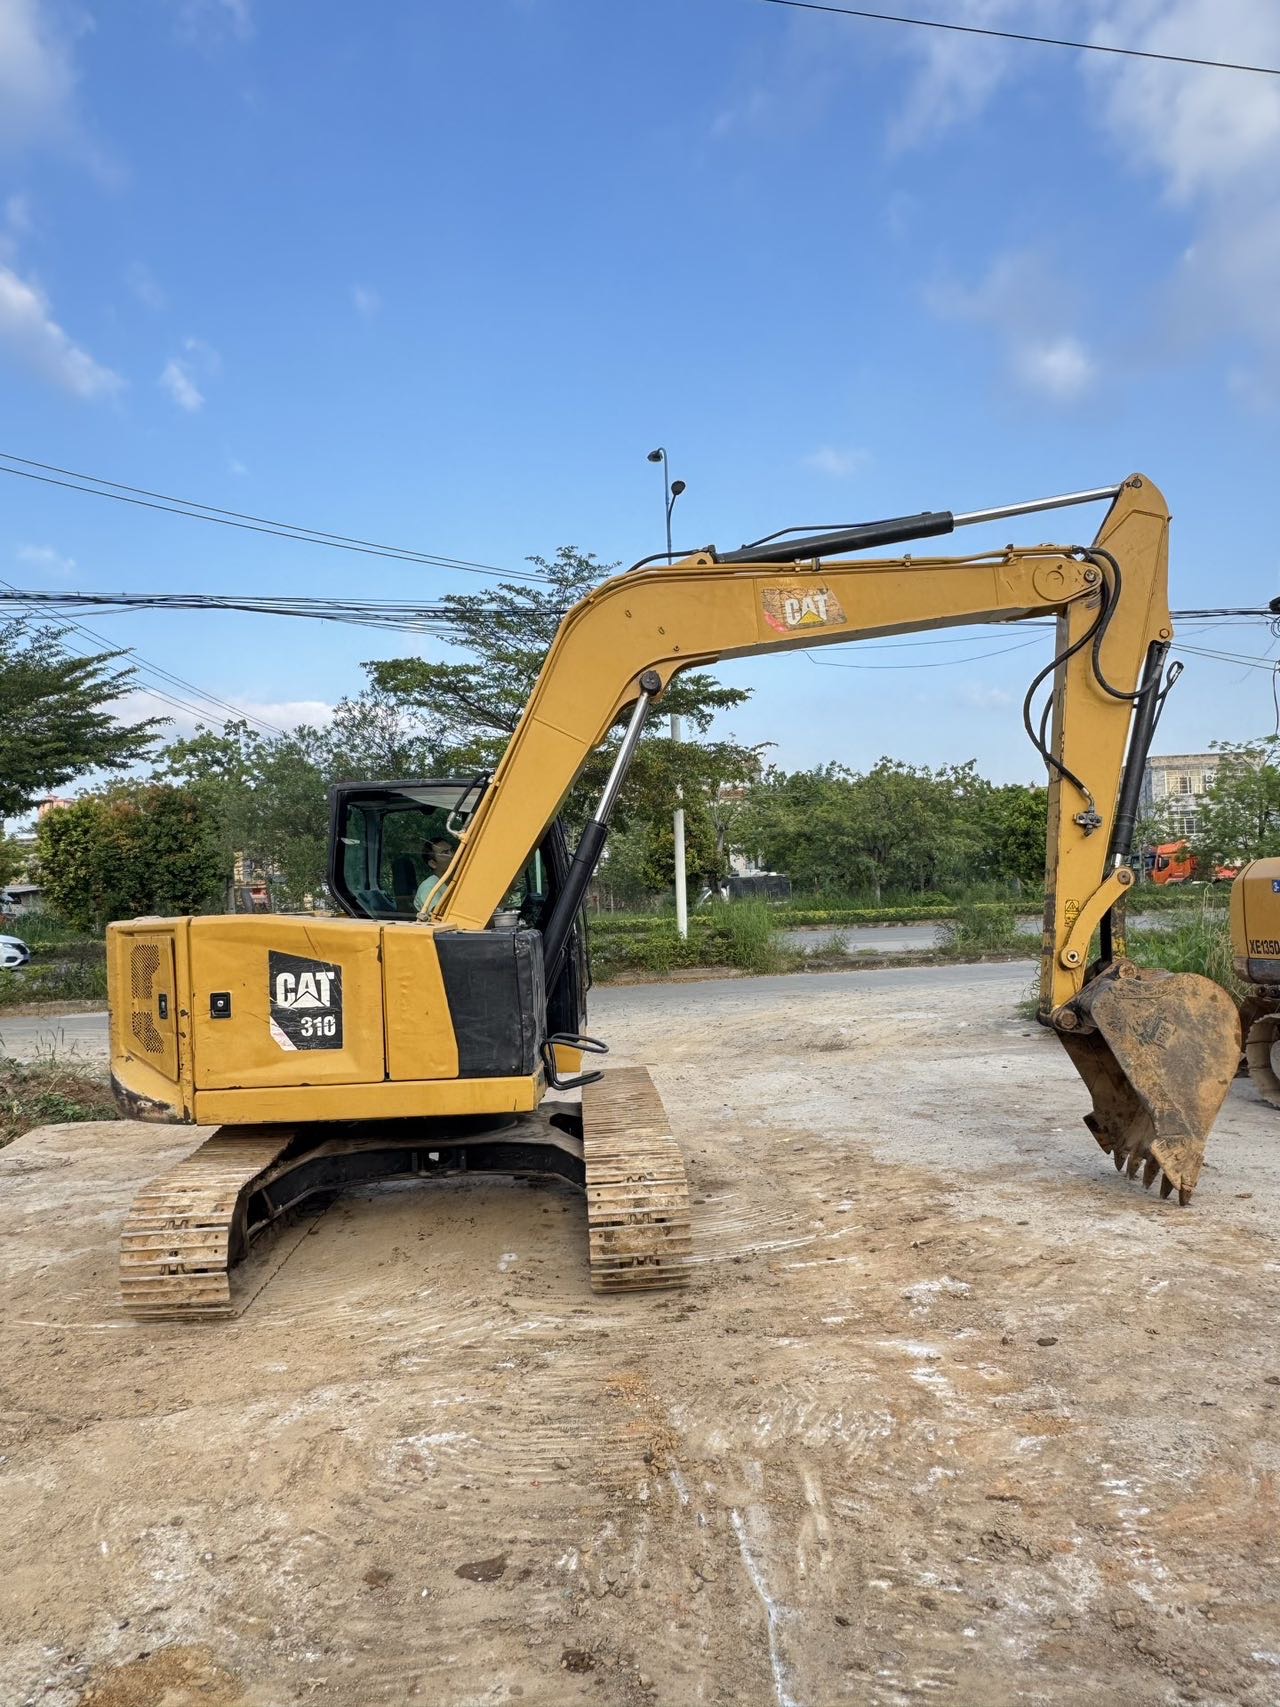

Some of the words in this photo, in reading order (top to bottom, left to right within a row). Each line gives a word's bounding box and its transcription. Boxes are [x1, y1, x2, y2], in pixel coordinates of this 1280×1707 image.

[785, 593, 828, 625] CAT
[276, 971, 334, 1008] CAT
[300, 1015, 336, 1037] 310
